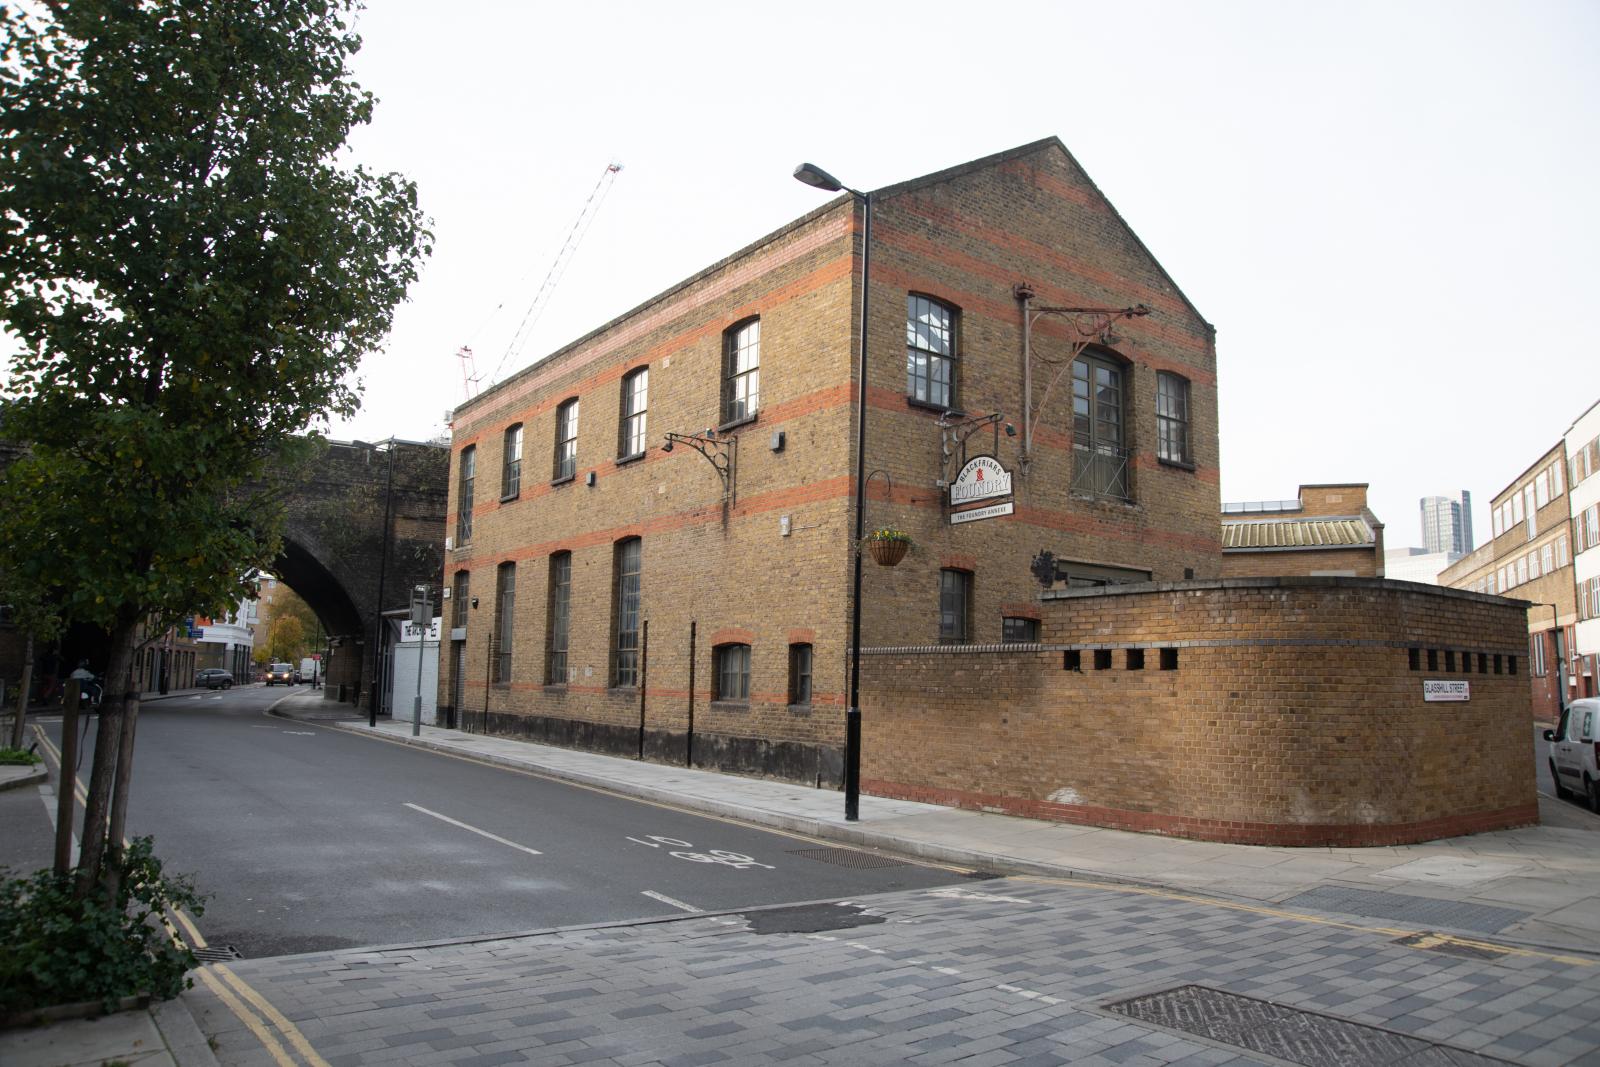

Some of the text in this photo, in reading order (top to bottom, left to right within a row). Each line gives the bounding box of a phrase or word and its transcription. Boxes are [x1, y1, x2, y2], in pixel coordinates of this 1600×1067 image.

[960, 459, 1001, 483] BLACKFRIARS
[956, 474, 1010, 499] FOUNDRY
[966, 511, 987, 519] FOUNDRY
[1425, 683, 1449, 693] GLASSHILL
[1449, 683, 1465, 693] STREET
